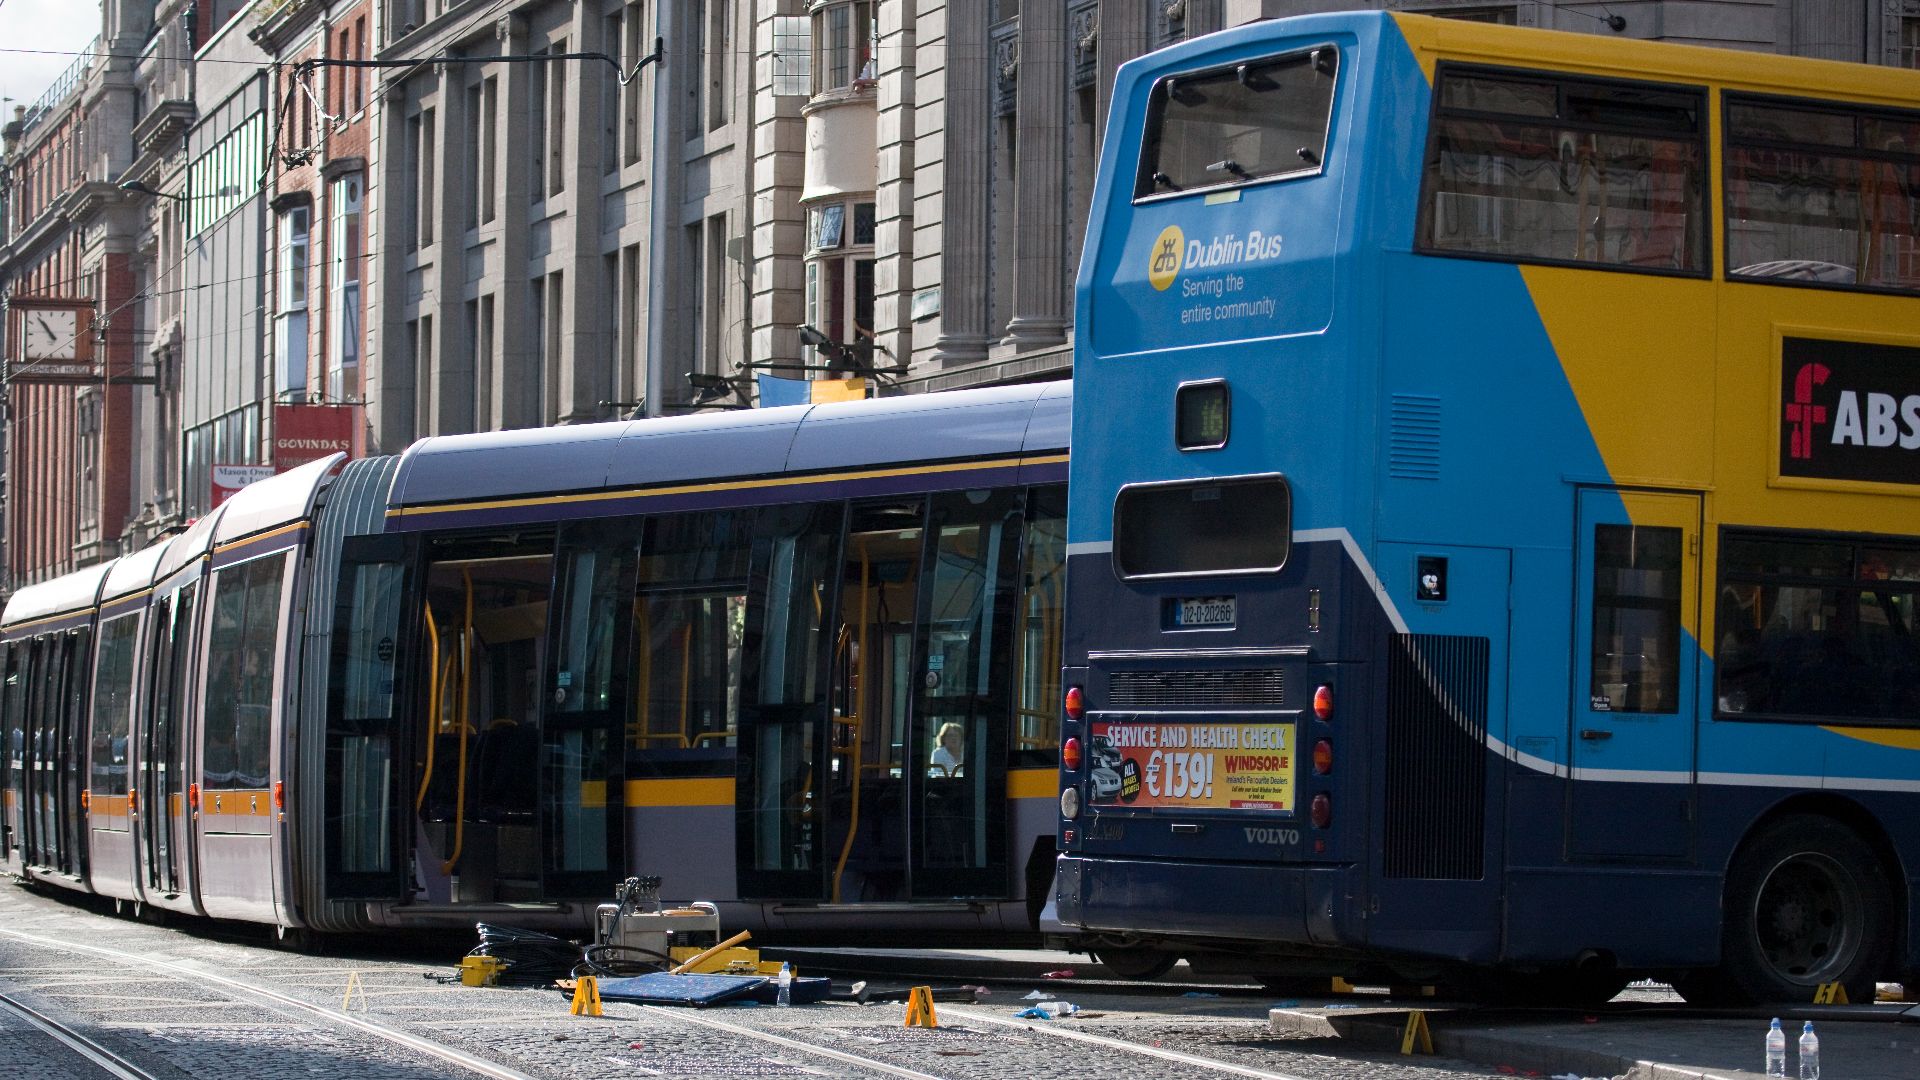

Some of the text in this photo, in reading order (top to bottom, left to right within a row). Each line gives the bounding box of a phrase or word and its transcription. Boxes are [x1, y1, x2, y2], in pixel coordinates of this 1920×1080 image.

[1184, 230, 1283, 270] Dublin Bus
[1182, 273, 1244, 298] Serving the
[1181, 296, 1276, 324] entire community
[219, 468, 247, 476] Mason
[1107, 725, 1286, 750] SERVICE AND HEALTH CHECK
[1125, 763, 1134, 777] ALL
[1145, 750, 1214, 798] €139!
[1225, 756, 1288, 773] WINDSOR.IE
[1226, 776, 1246, 784] Ireland's
[1270, 777, 1288, 785] Dealers
[1243, 827, 1299, 845] VOLVO
[586, 979, 596, 1004] 2
[920, 989, 930, 1015] 3
